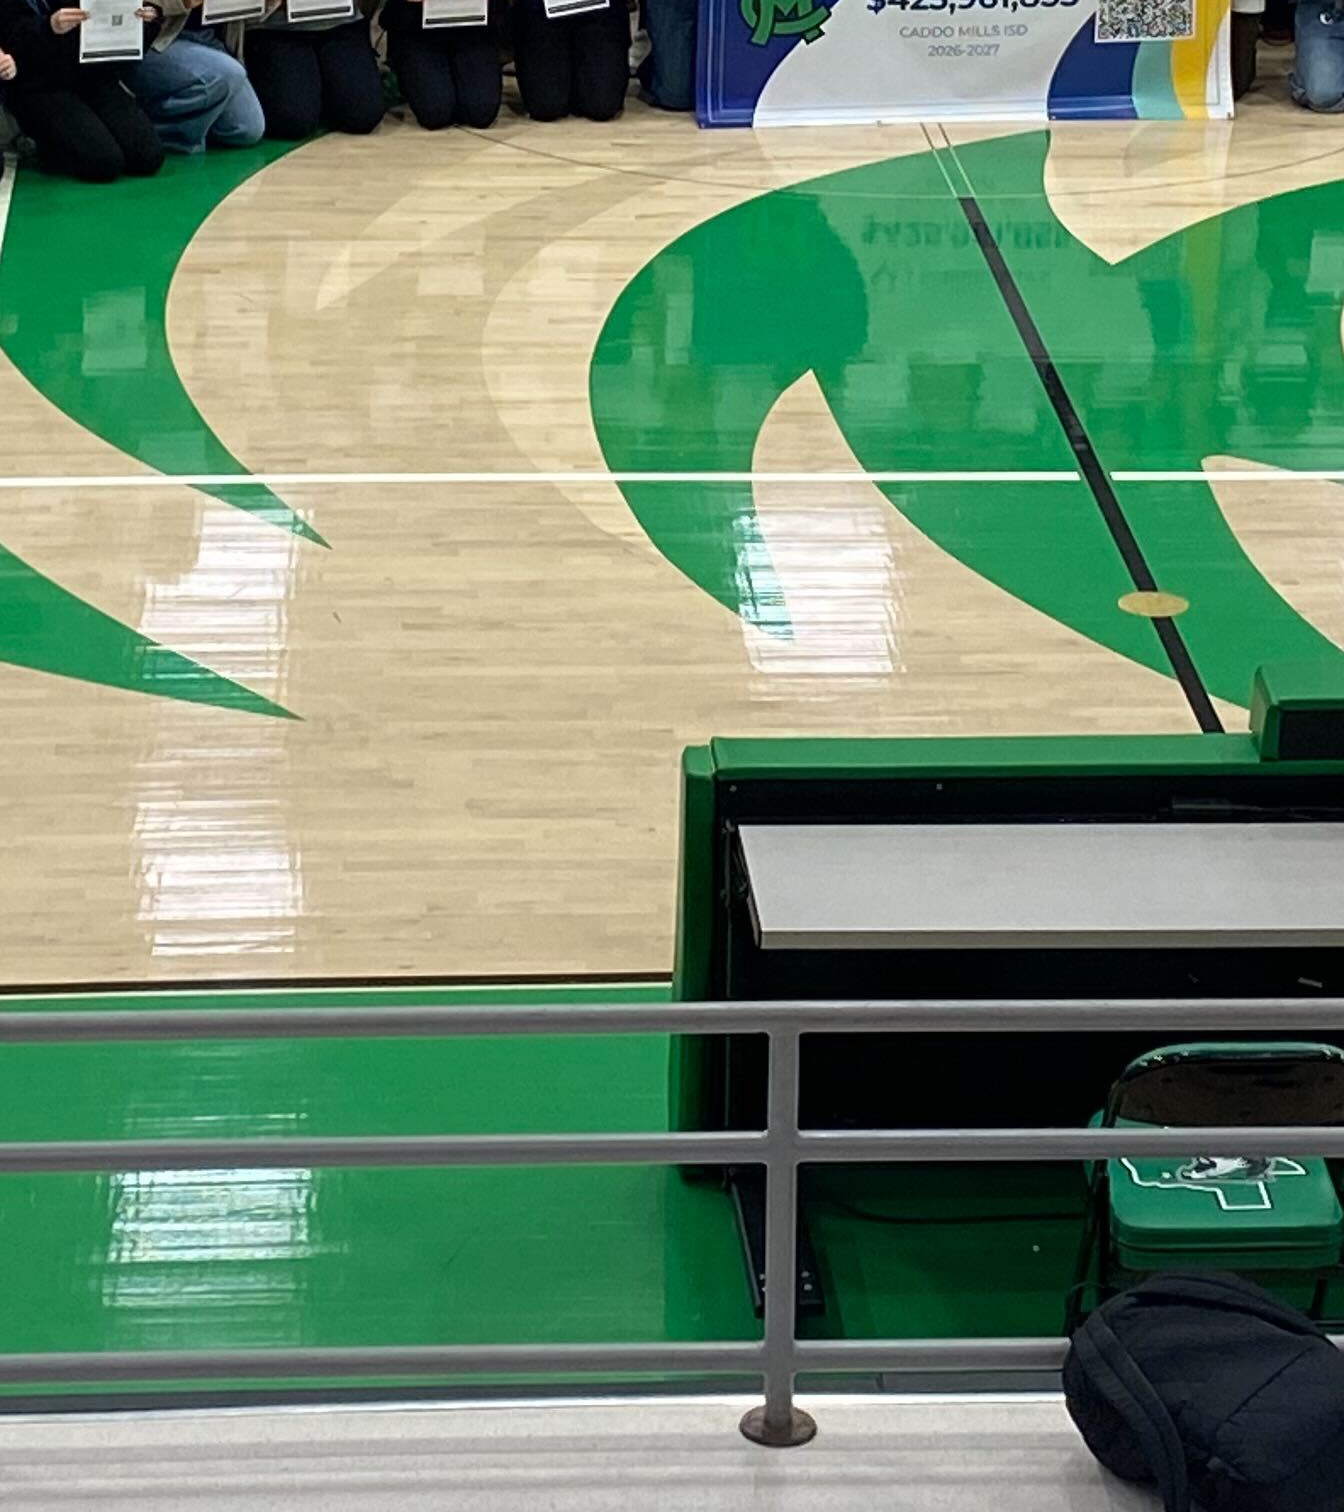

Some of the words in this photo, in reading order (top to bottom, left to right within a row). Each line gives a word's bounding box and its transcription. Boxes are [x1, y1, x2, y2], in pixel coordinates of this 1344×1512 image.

[899, 25, 955, 39] CADDO
[958, 24, 1001, 37] MILLS
[1004, 23, 1029, 37] ISD
[927, 43, 1001, 57] 2026-2027
